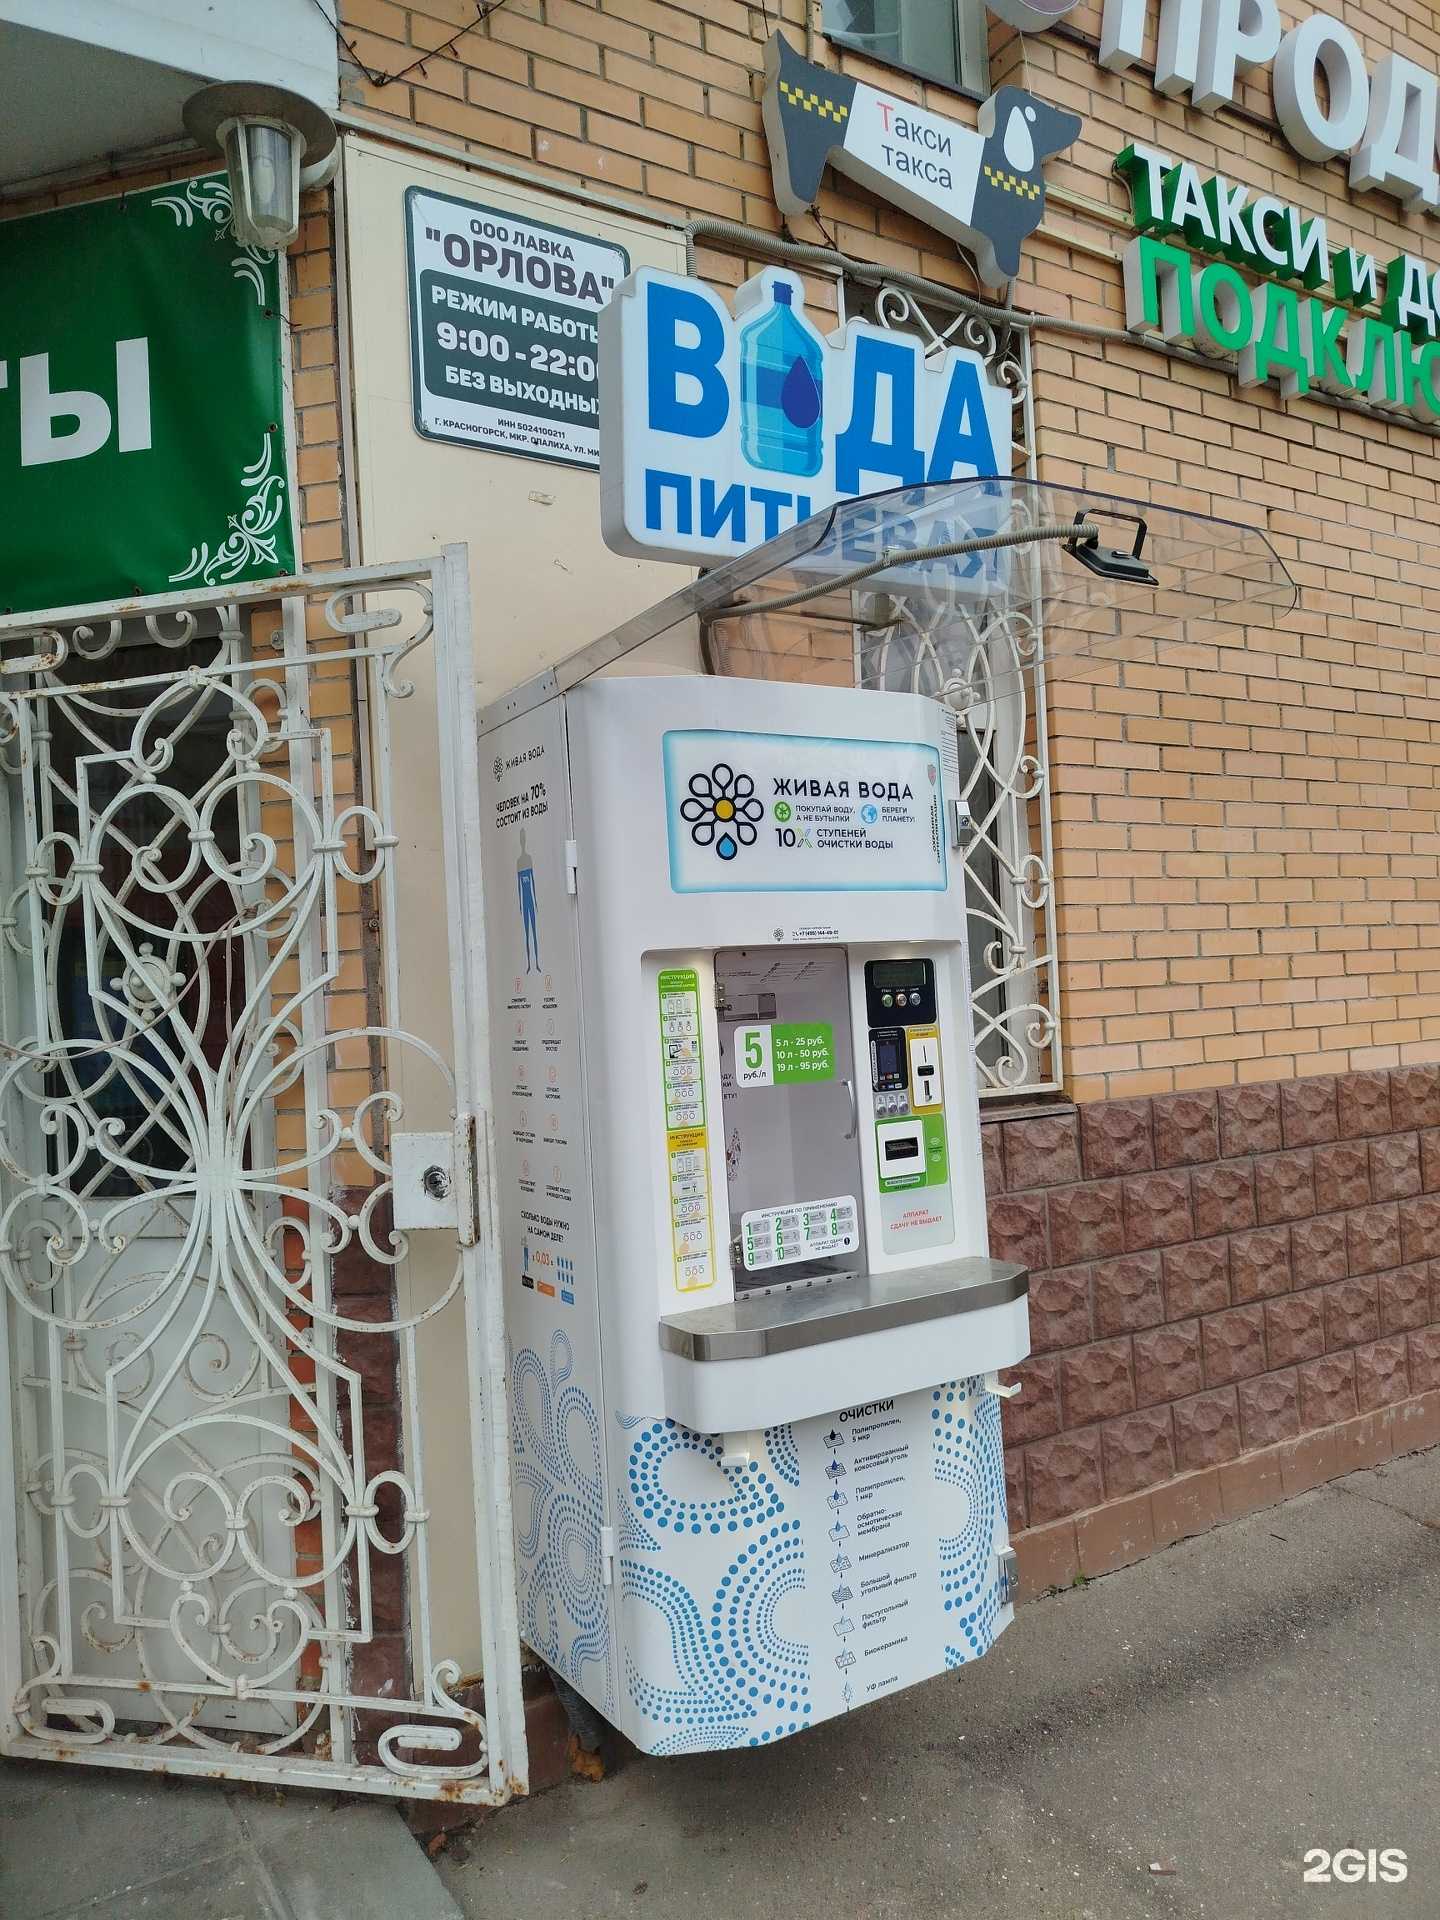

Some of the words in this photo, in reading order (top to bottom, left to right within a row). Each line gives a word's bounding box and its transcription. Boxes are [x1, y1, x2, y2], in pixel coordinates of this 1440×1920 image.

[876, 101, 951, 157] Такси
[881, 144, 952, 190] такса
[469, 218, 509, 242] ООО
[512, 230, 575, 262] ЛАВКА
[1132, 143, 1330, 283] ТАКСИ
[1348, 247, 1378, 301] и
[1397, 254, 1440, 336] Д
[425, 226, 615, 305] "ОРЛОВА"
[431, 284, 517, 324] РЕЖИМ
[436, 321, 510, 362] 9:00
[515, 352, 527, 361] -
[529, 343, 600, 383] 22:0
[445, 364, 486, 391] БЕЗ
[489, 375, 600, 415] ВЫХОДНЫ
[646, 280, 1004, 506] ВДА
[0, 336, 152, 467] Ы
[443, 419, 508, 440] КРАСНОГОРСК,
[509, 432, 530, 443] МКР.
[573, 445, 586, 455] УЛ.
[497, 418, 516, 429] ИНН
[517, 422, 566, 439] 5024100211
[505, 752, 527, 771] ЖИВАЯ
[528, 744, 545, 761] ВОДА
[496, 795, 521, 813] ЧЕЛОВЕК
[520, 792, 529, 802] НА
[530, 782, 547, 800] 70%
[773, 777, 850, 798] ЖИВАЯ
[858, 781, 914, 802] ВОДА
[496, 810, 522, 829] СОСТОИТ
[522, 807, 530, 819] ИЗ
[795, 804, 832, 813] ПОКУПАЙ
[881, 806, 908, 814] БЕРЕГИ
[816, 828, 867, 838] СТУПЕНЕЙ
[817, 840, 863, 849] ОЧИСТКИ
[865, 840, 894, 850] ВОДЫ
[745, 1031, 763, 1069] 5
[775, 1039, 782, 1047] 5
[795, 1037, 806, 1046] 25
[807, 1036, 825, 1048] руб.
[776, 1051, 785, 1060] 10
[800, 1050, 810, 1058] 50
[812, 1049, 829, 1060] руб.
[743, 1070, 767, 1080] руб./л
[776, 1063, 785, 1072] 19
[787, 1063, 793, 1071] л
[799, 1061, 810, 1070] 95
[812, 1060, 829, 1072] руб.
[745, 1222, 752, 1236] 1
[775, 1217, 782, 1231] 2
[802, 1212, 810, 1226] 3
[830, 1207, 837, 1221] 4
[902, 1209, 929, 1218] АППАРАТ
[890, 1221, 909, 1230] СДАЧУ
[747, 1236, 754, 1251] 5
[776, 1232, 783, 1246] 6
[803, 1227, 810, 1240] 7
[831, 1222, 838, 1236] 8
[748, 1252, 755, 1266] 9
[775, 1247, 785, 1260] 10
[839, 1400, 894, 1422] ОЧИСТКИ
[851, 1417, 902, 1435] Полипропилен,
[857, 1433, 871, 1442] мкр
[853, 1443, 909, 1465] Активированный
[854, 1456, 889, 1473] кокосовый
[890, 1453, 909, 1464] уголь
[855, 1476, 906, 1495] Полипропилен,
[859, 1492, 873, 1501] мкр
[856, 1508, 887, 1521] Обратно-
[857, 1510, 903, 1529] осмотическая
[857, 1522, 891, 1536] мембрана
[858, 1541, 910, 1561] Минерализатор
[860, 1572, 891, 1588] Большой
[860, 1579, 893, 1597] угольный
[893, 1572, 917, 1585] фильтр
[862, 1599, 909, 1621] Постугольный
[862, 1616, 887, 1630] фильтр
[864, 1636, 908, 1657] Биокерамика
[866, 1682, 877, 1692] УФ
[877, 1675, 898, 1687] лампа
